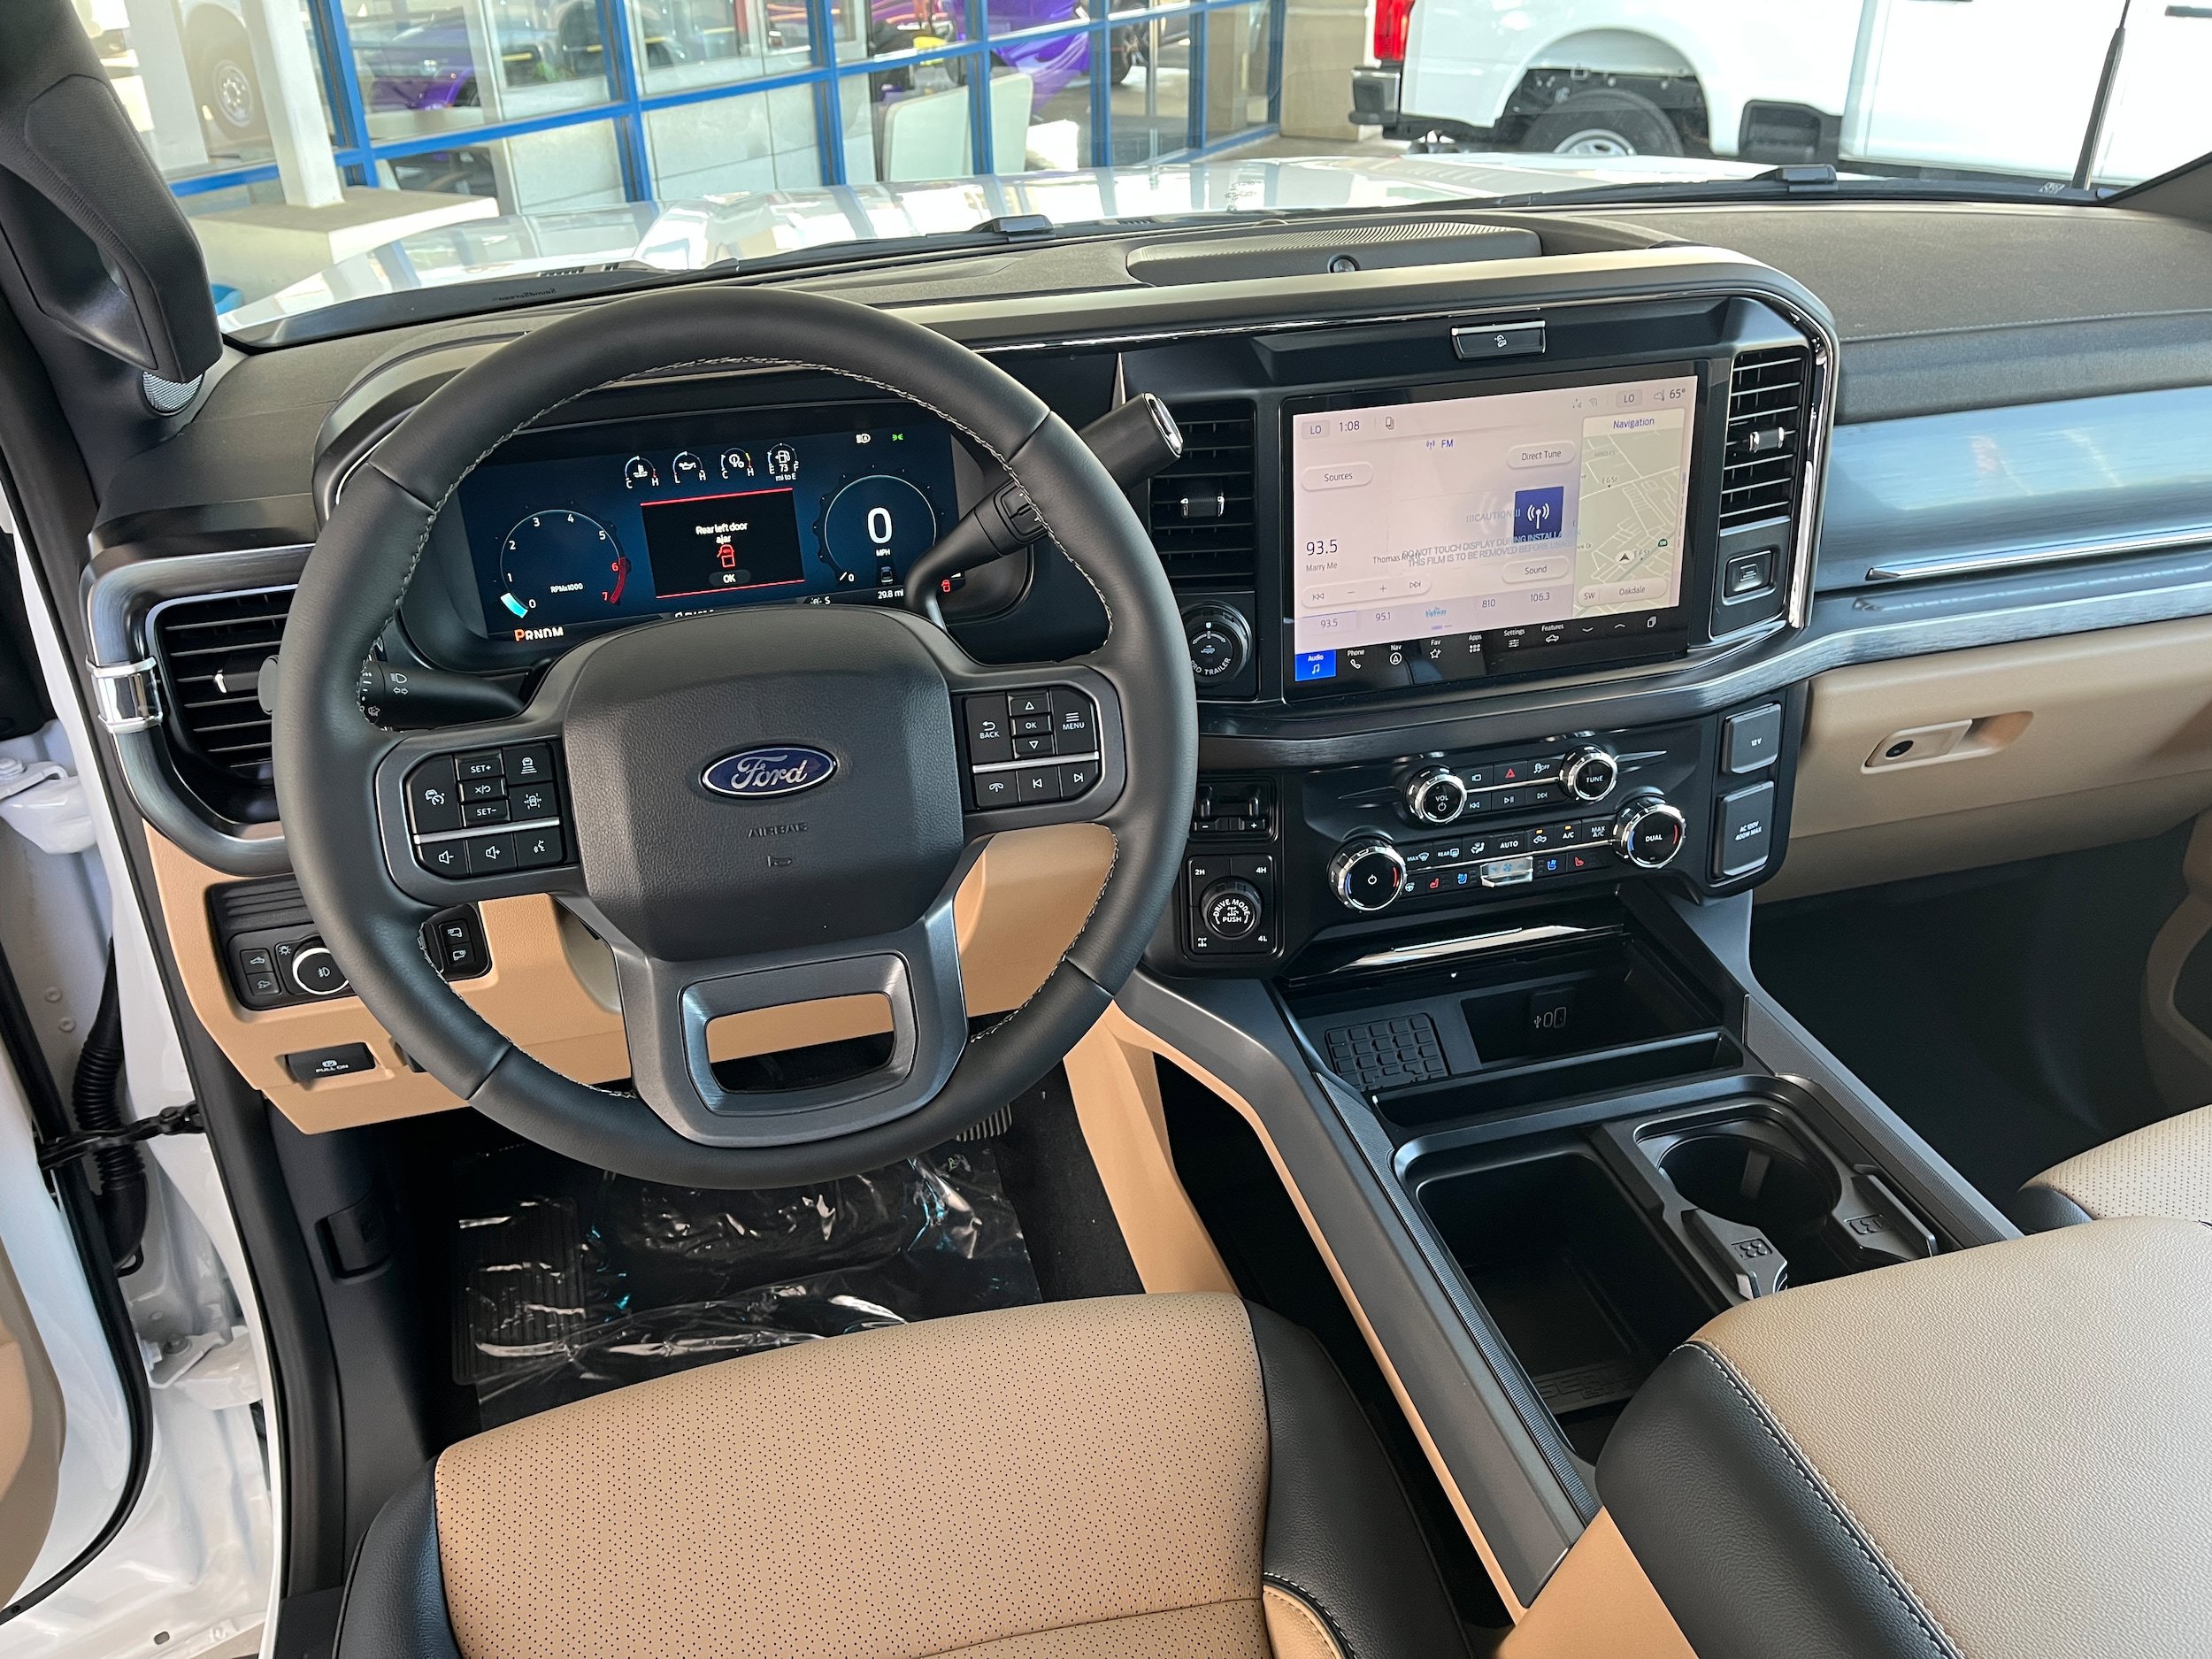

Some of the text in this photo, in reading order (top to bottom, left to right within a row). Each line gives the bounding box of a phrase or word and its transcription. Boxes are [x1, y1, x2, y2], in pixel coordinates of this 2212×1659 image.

[1624, 394, 1635, 403] LO
[1339, 420, 1360, 432] 1:08
[1613, 418, 1655, 429] Navigation
[1310, 425, 1322, 434] LO
[1440, 439, 1454, 449] FM
[1521, 449, 1562, 461] Direct Tune
[770, 465, 775, 474] E
[779, 464, 788, 472] 73
[794, 463, 799, 472] F
[699, 472, 707, 481] H
[722, 471, 728, 480] C
[747, 468, 755, 477] H
[1324, 472, 1353, 482] Sources
[651, 478, 659, 487] H
[674, 475, 680, 484] L
[533, 518, 541, 527] 3
[567, 513, 575, 523] 4
[695, 522, 748, 534] Rear left door
[867, 507, 893, 544] 0
[599, 531, 606, 540] 5
[716, 534, 732, 544] ajar
[509, 541, 516, 550] 2
[1306, 539, 1338, 557] 93.5
[1417, 548, 1432, 557] NOT
[1435, 544, 1461, 555] TOUCH
[1463, 540, 1495, 551] DISPLAY
[1373, 556, 1400, 565] Thomas
[1409, 557, 1425, 566] THIS
[1426, 556, 1446, 565] FILM
[1479, 547, 1517, 557] REMOVED
[611, 562, 618, 572] 6
[1306, 564, 1325, 572] Marry
[1525, 565, 1547, 575] Sound
[507, 572, 513, 582] 1
[723, 574, 736, 583] OK
[877, 588, 904, 600] 29.8 mi
[1619, 587, 1646, 595] Oakdale
[602, 592, 609, 601] 7
[825, 596, 831, 605] S
[1530, 592, 1550, 603] 106.3
[528, 599, 536, 608] 0
[1482, 599, 1495, 608] 810
[1375, 611, 1391, 621] 95.1
[1320, 618, 1338, 628] 93.5
[1504, 628, 1525, 637] Settings
[1204, 657, 1231, 675] TRAILER
[1062, 721, 1085, 730] MENU
[979, 731, 1000, 740] BACK
[471, 764, 492, 773] SET+
[731, 754, 808, 789] Ford
[1212, 899, 1251, 918] DRIVE MODE
